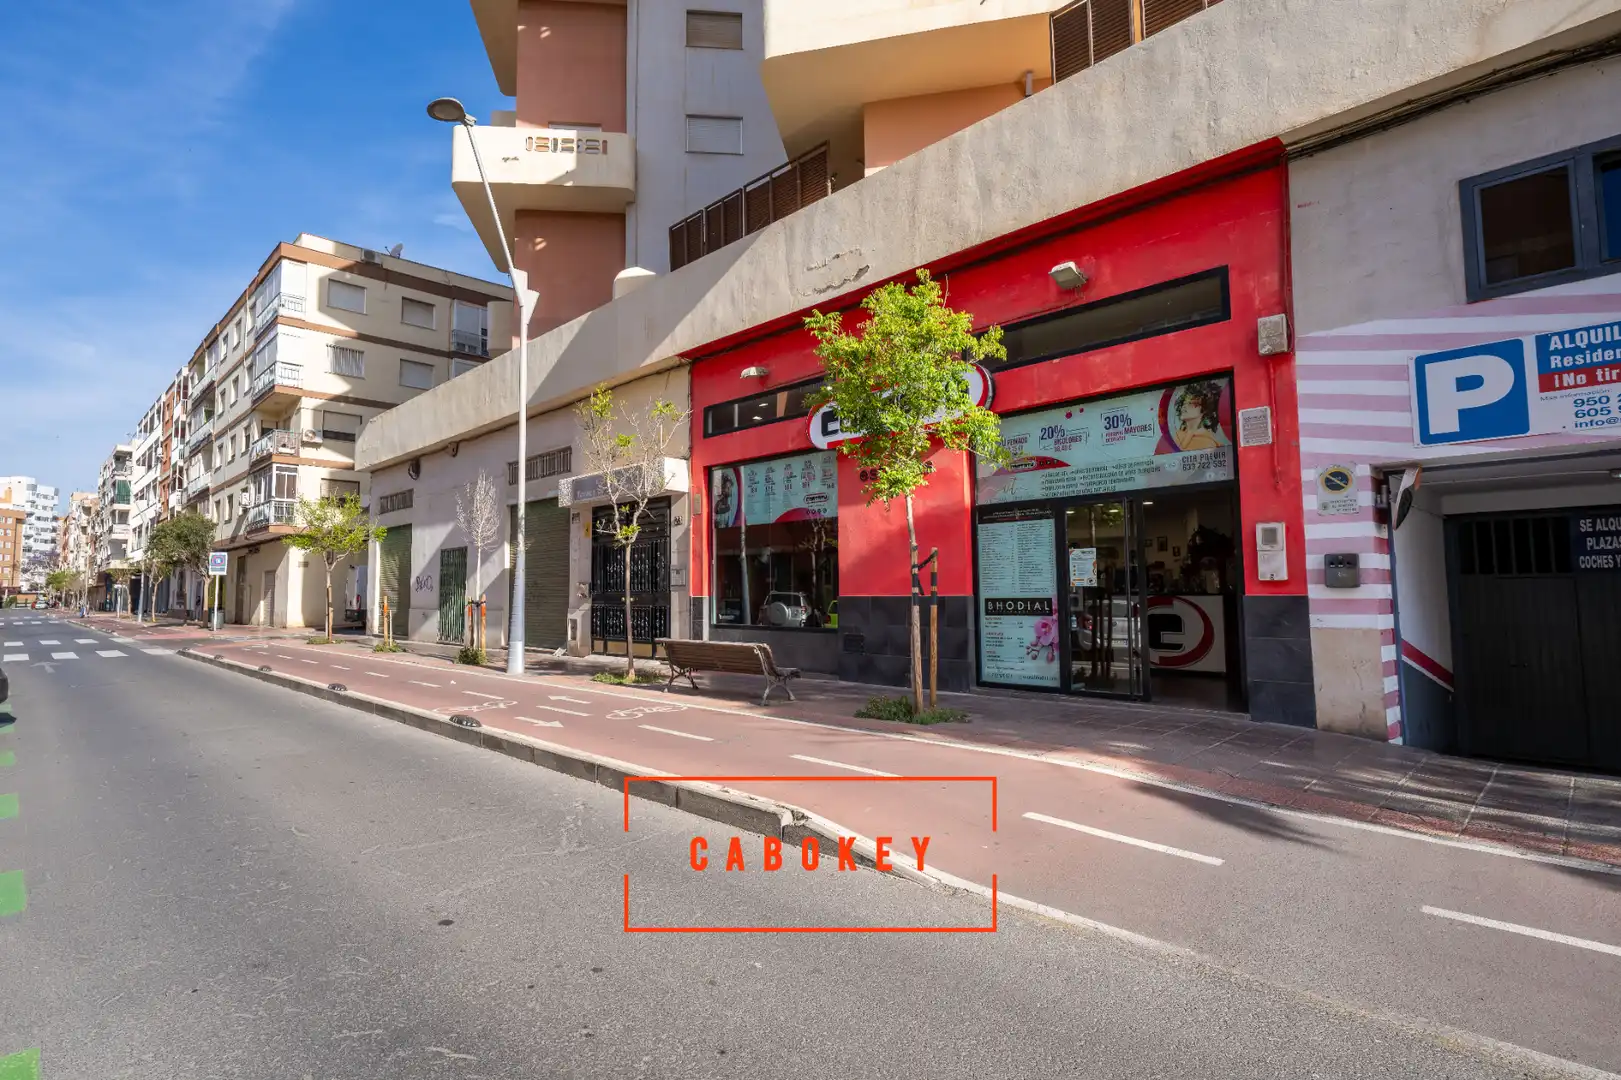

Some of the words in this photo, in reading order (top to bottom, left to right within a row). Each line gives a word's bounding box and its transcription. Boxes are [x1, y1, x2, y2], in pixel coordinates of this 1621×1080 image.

[1424, 354, 1514, 435] P
[1573, 395, 1610, 408] 950
[1574, 406, 1612, 419] 605
[1104, 413, 1131, 430] 30%
[1574, 416, 1621, 429] info@
[1040, 425, 1065, 441] 20%
[1123, 423, 1153, 435] MAYORES
[1182, 455, 1197, 463] CITA
[1200, 451, 1226, 461] PREVIA
[1580, 518, 1593, 532] SE
[1596, 517, 1621, 532] ALQU
[1579, 554, 1614, 569] COCHES
